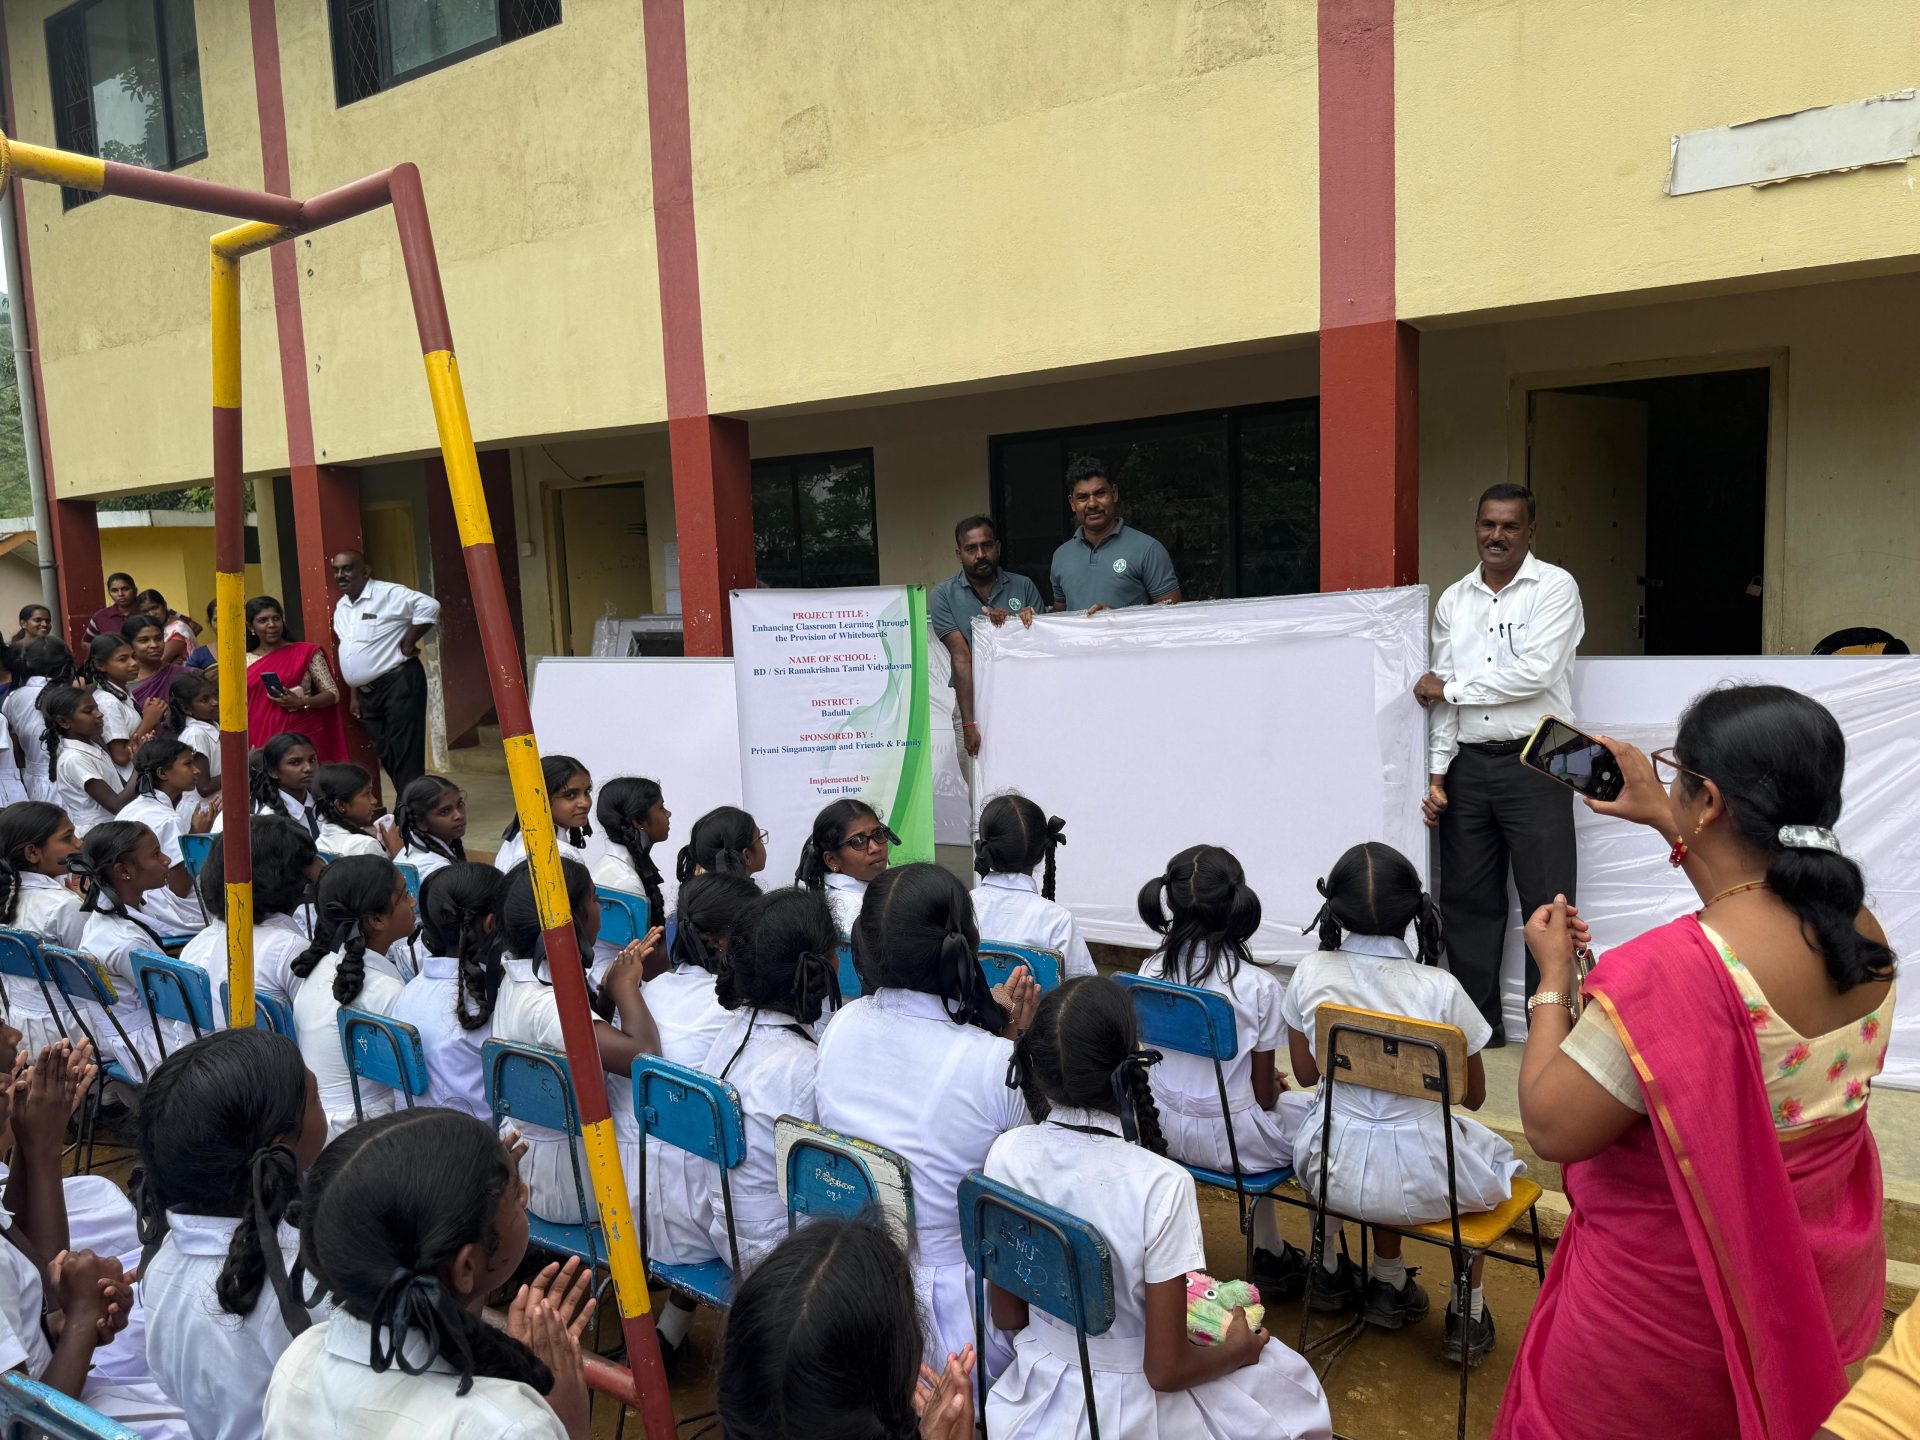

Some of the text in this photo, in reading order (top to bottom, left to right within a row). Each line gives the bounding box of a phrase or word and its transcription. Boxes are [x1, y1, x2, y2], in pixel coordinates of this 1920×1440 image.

[793, 611, 834, 620] PROJECT
[836, 610, 863, 618] TITLE
[752, 619, 909, 633] Enhancing Classroom Learning Through
[775, 631, 888, 643] the Provision of Whiteboards
[789, 656, 816, 664] NAME
[819, 655, 831, 663] OF
[834, 654, 871, 662] SCHOOL
[754, 668, 766, 676] BD
[774, 668, 786, 676] Sri
[789, 665, 840, 674] Ramakrishna
[842, 664, 865, 672] Tamil
[867, 662, 912, 671] Vidyalayam
[812, 698, 854, 707] DISTRICT
[822, 709, 851, 717] Badulla
[800, 733, 853, 742] SPONSORED
[856, 732, 868, 740] BY
[751, 746, 780, 756] Priyani
[781, 744, 837, 754] Singanayagam
[839, 743, 854, 751] and
[856, 741, 885, 749] Friends
[896, 739, 922, 747] Family
[809, 775, 870, 785] Implemented by
[817, 786, 862, 795] Vanni Hope
